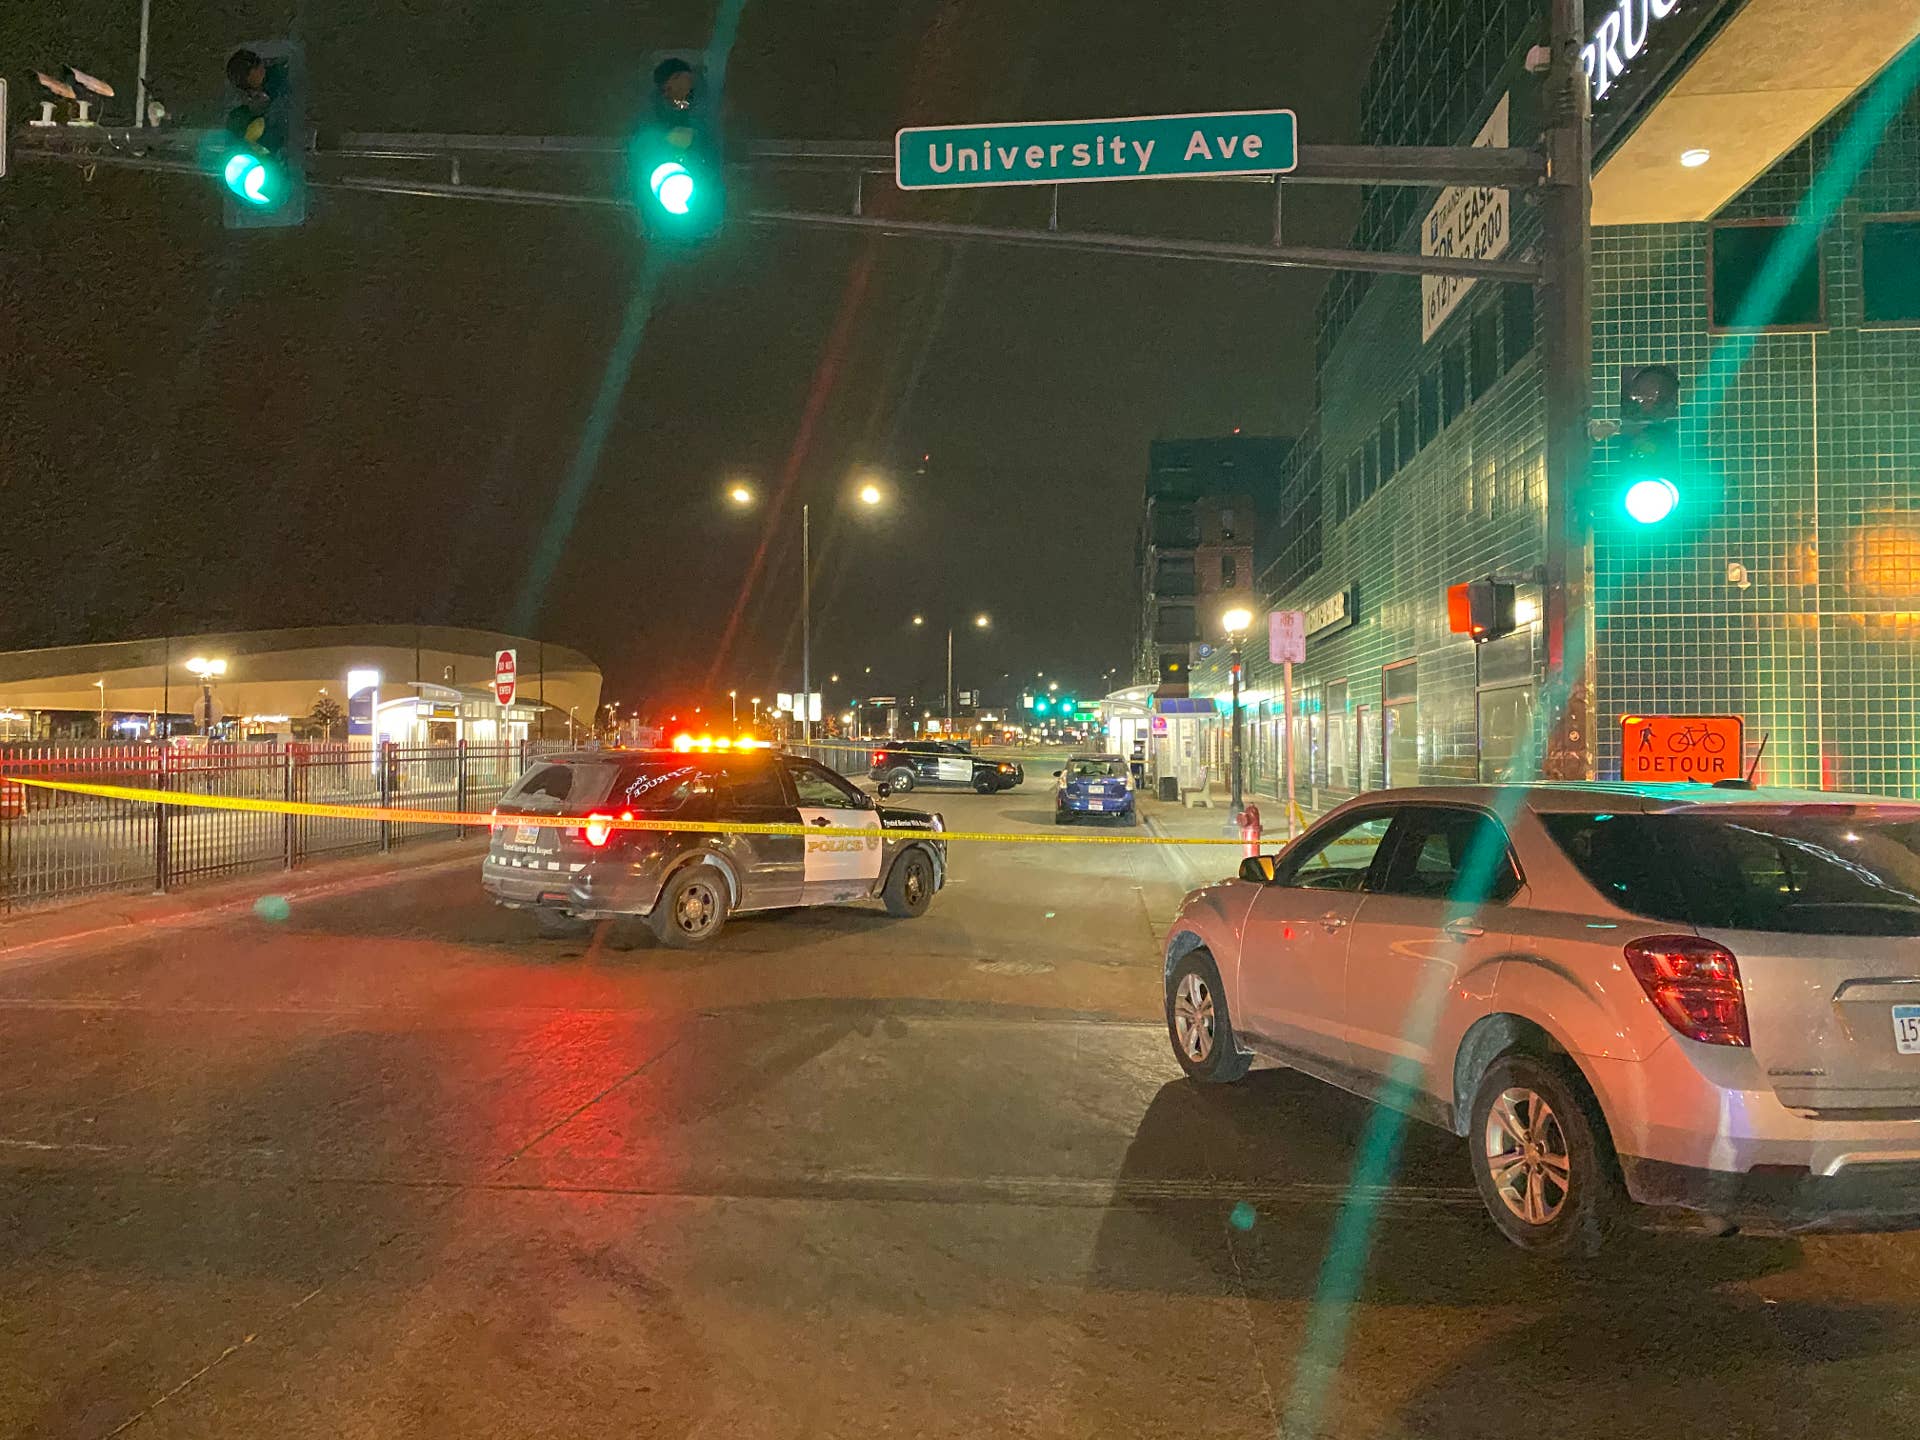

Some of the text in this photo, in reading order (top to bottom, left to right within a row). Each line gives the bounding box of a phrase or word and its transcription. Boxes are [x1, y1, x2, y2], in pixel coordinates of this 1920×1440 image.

[929, 130, 1263, 173] University Ave
[1638, 756, 1725, 772] DETOUR
[808, 841, 863, 852] POLICE
[1899, 1018, 1920, 1043] 15
